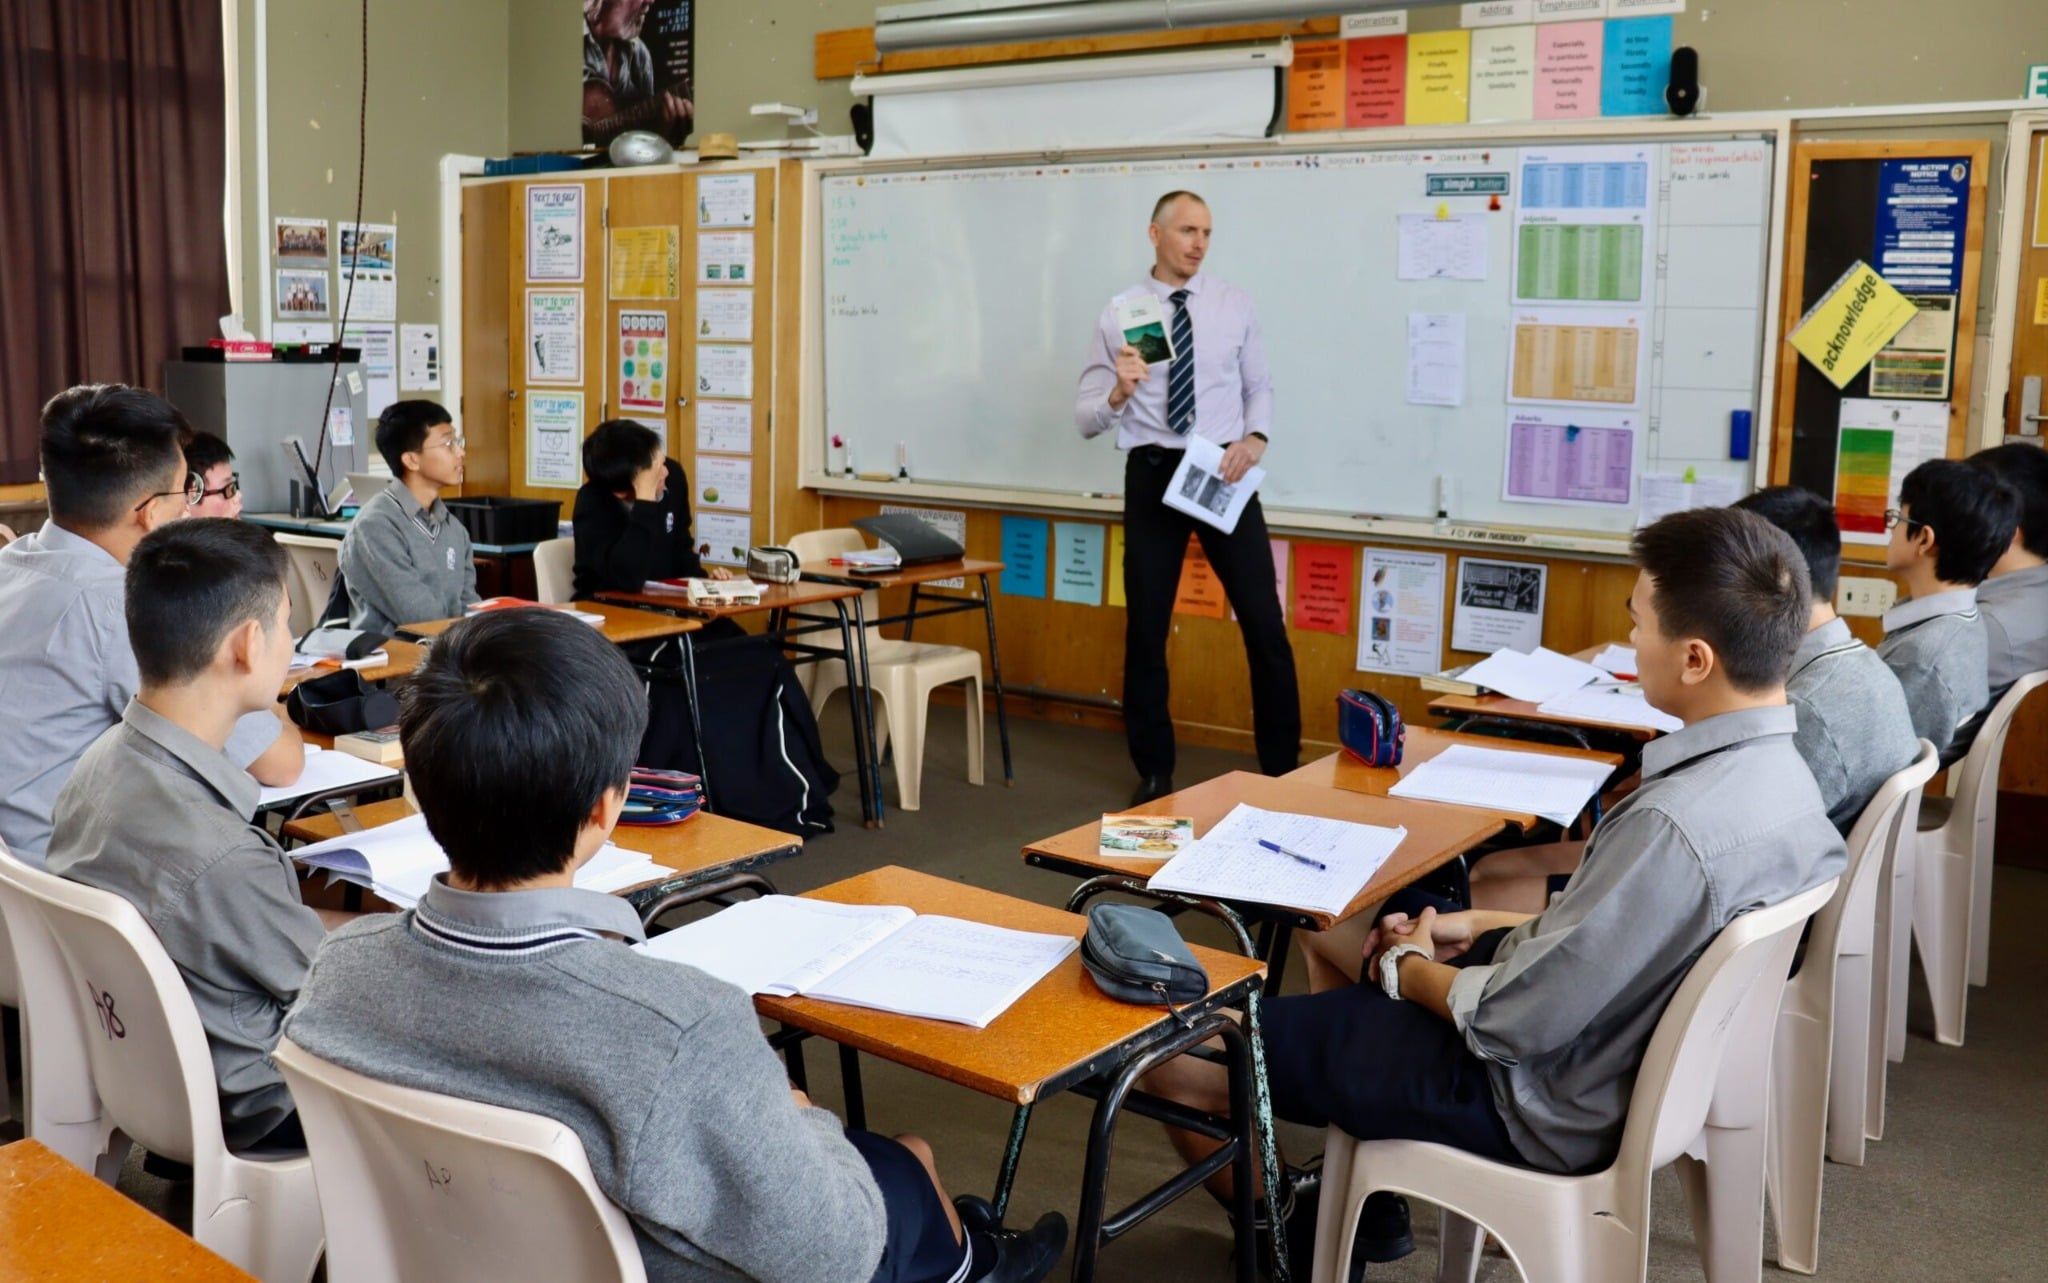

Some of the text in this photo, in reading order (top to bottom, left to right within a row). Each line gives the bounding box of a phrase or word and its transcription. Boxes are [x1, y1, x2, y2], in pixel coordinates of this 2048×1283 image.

[1480, 5, 1513, 16] Adding
[1348, 15, 1399, 28] Contrasting
[1901, 164, 1919, 172] FIRE
[1443, 177, 1475, 192] simple
[1477, 176, 1504, 190] better
[1822, 274, 1877, 371] acknowledge
